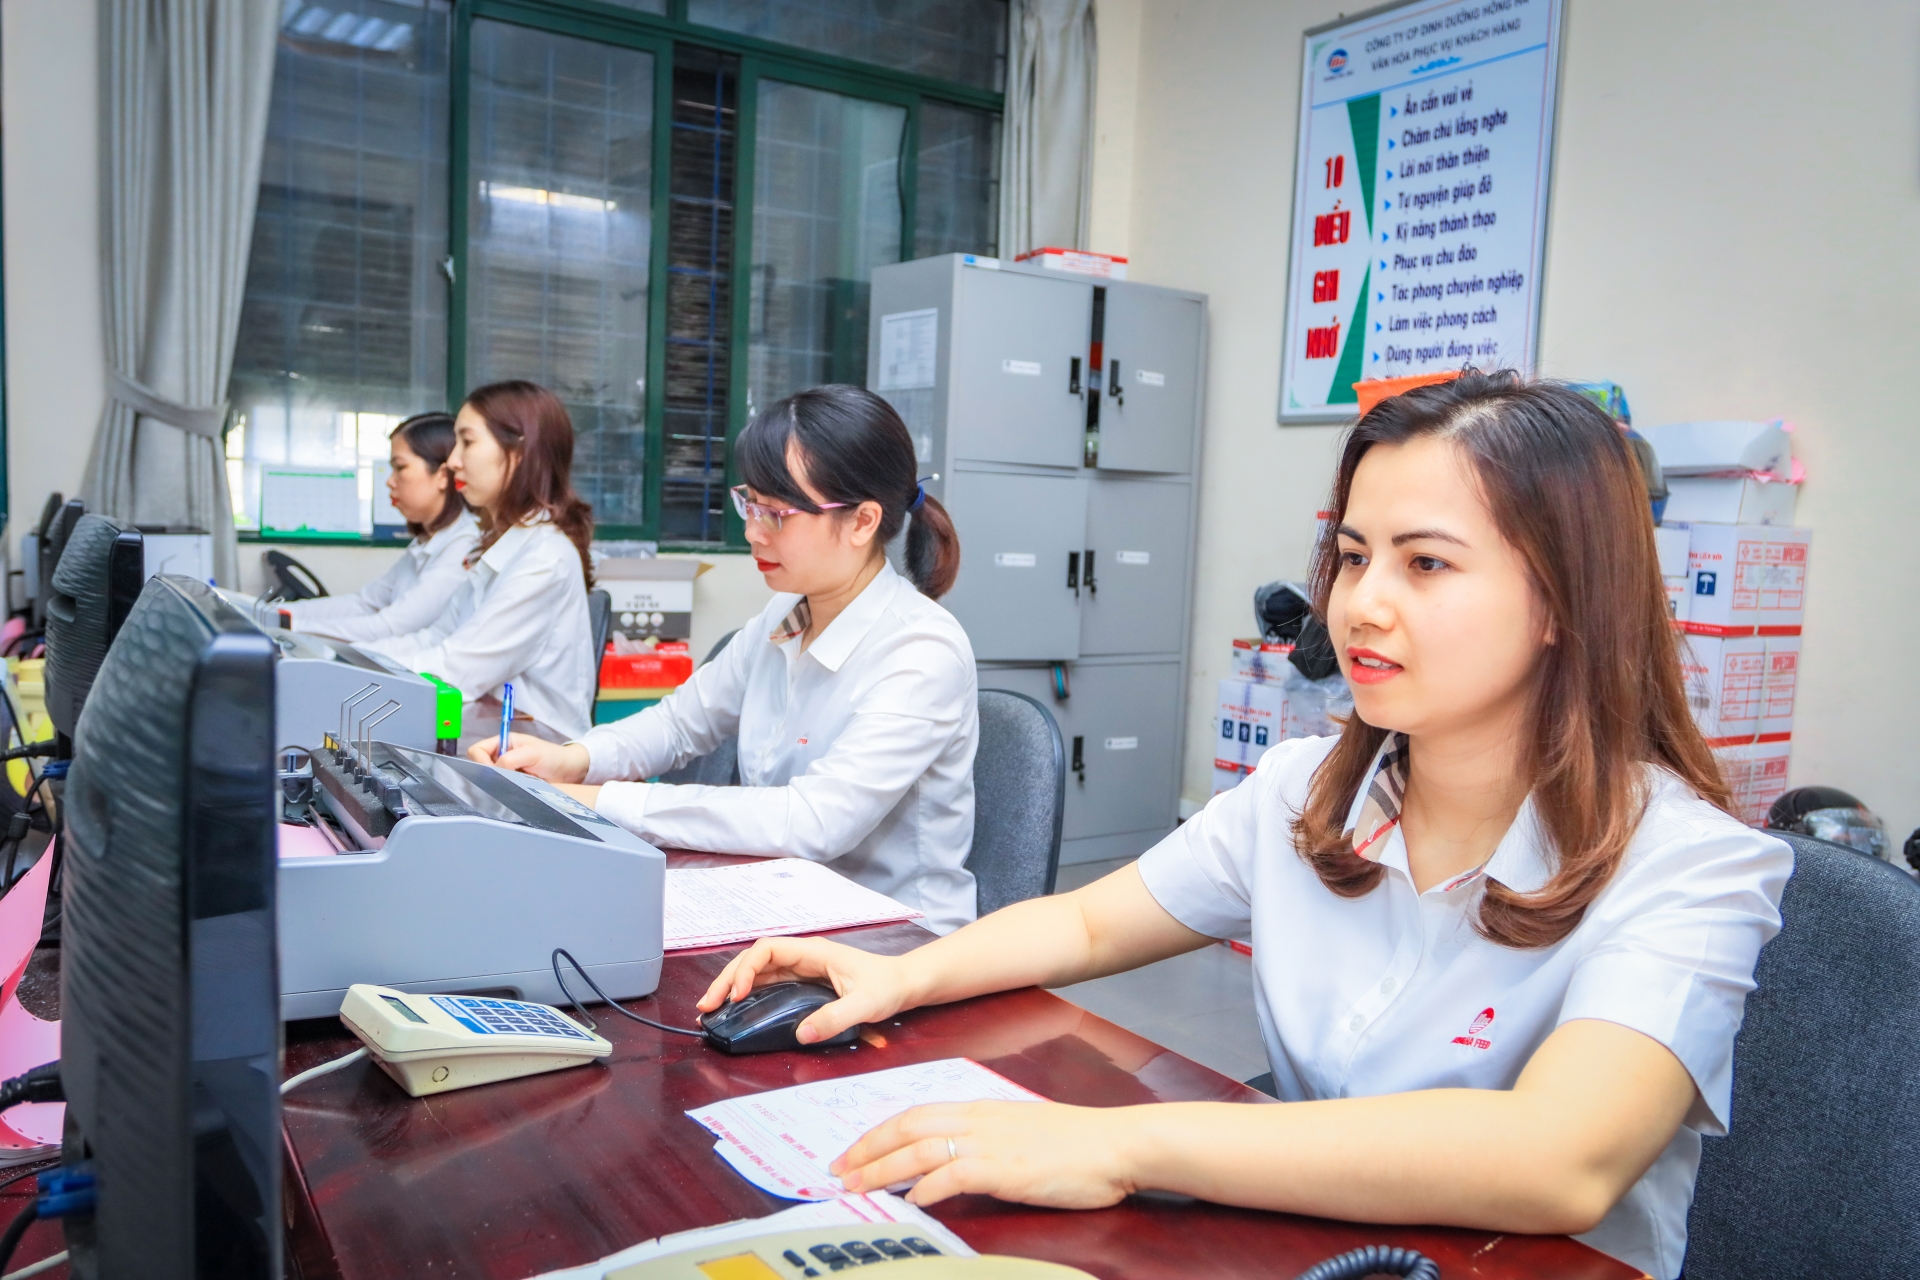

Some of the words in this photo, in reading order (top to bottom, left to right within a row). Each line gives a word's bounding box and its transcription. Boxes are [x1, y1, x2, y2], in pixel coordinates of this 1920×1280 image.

[1482, 108, 1508, 132] nghe
[1325, 154, 1345, 189] 10
[1314, 199, 1352, 248] ĐIỀU
[1436, 247, 1454, 265] chu
[1313, 268, 1340, 304] GHI
[1412, 282, 1443, 303] phong
[1436, 309, 1468, 331] phong
[1305, 315, 1341, 360] NHỚ
